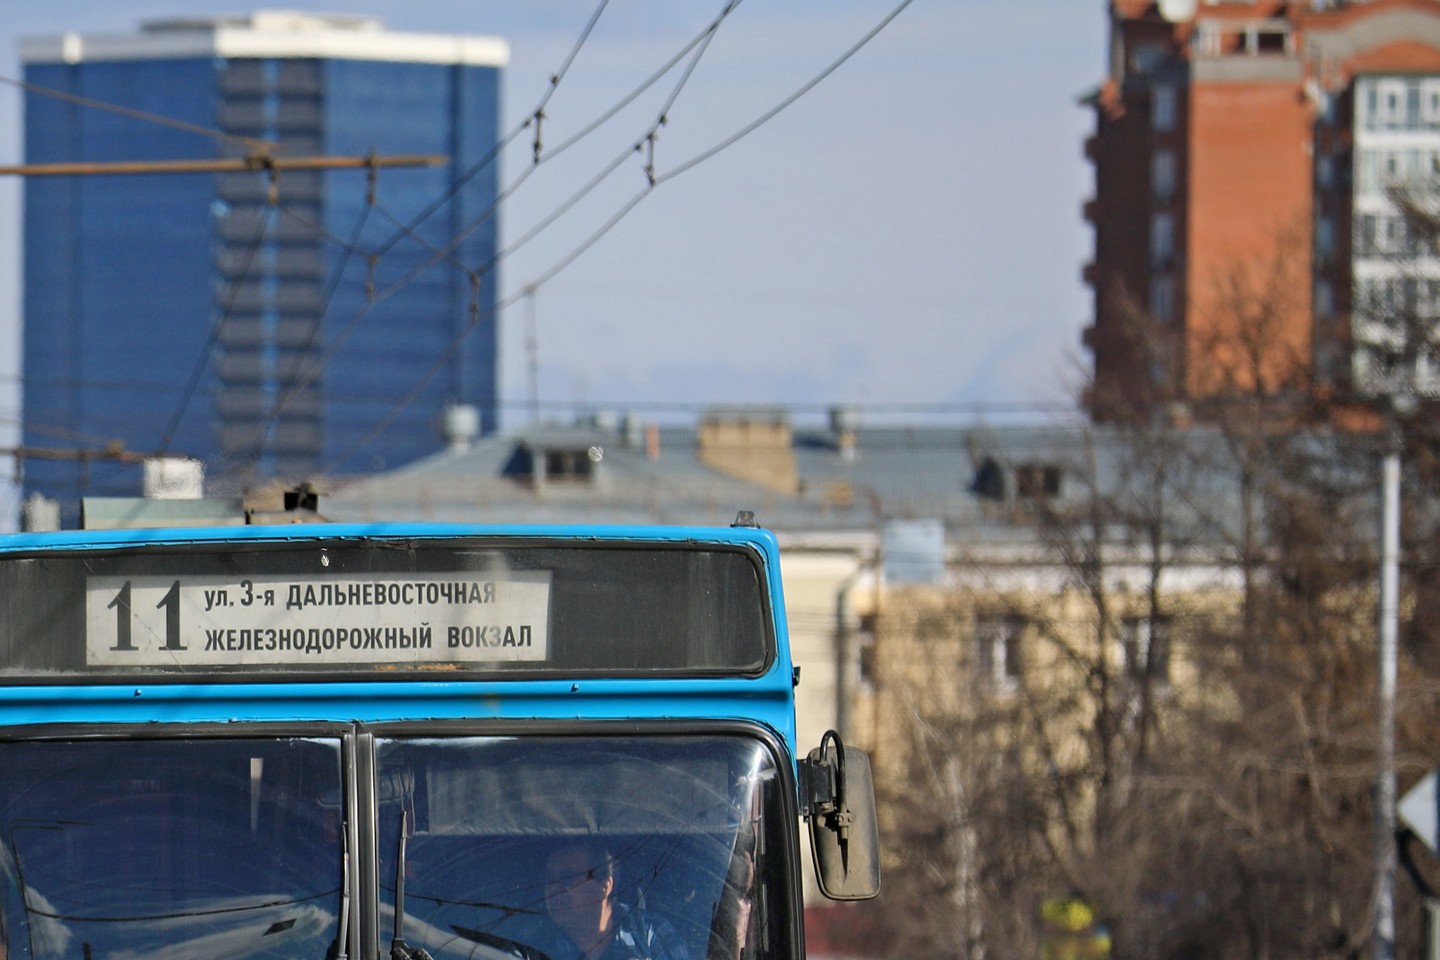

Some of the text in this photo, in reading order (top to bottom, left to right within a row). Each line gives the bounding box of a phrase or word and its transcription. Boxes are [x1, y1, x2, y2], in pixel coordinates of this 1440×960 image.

[205, 579, 496, 611] ул. 3-я ДАЛЬНЕВОСТОЧНАЯ
[107, 580, 188, 651] 11
[205, 621, 532, 654] ЖЕЛЕЗНОДОРОЖНЫЙ ВОКЗАЛ
